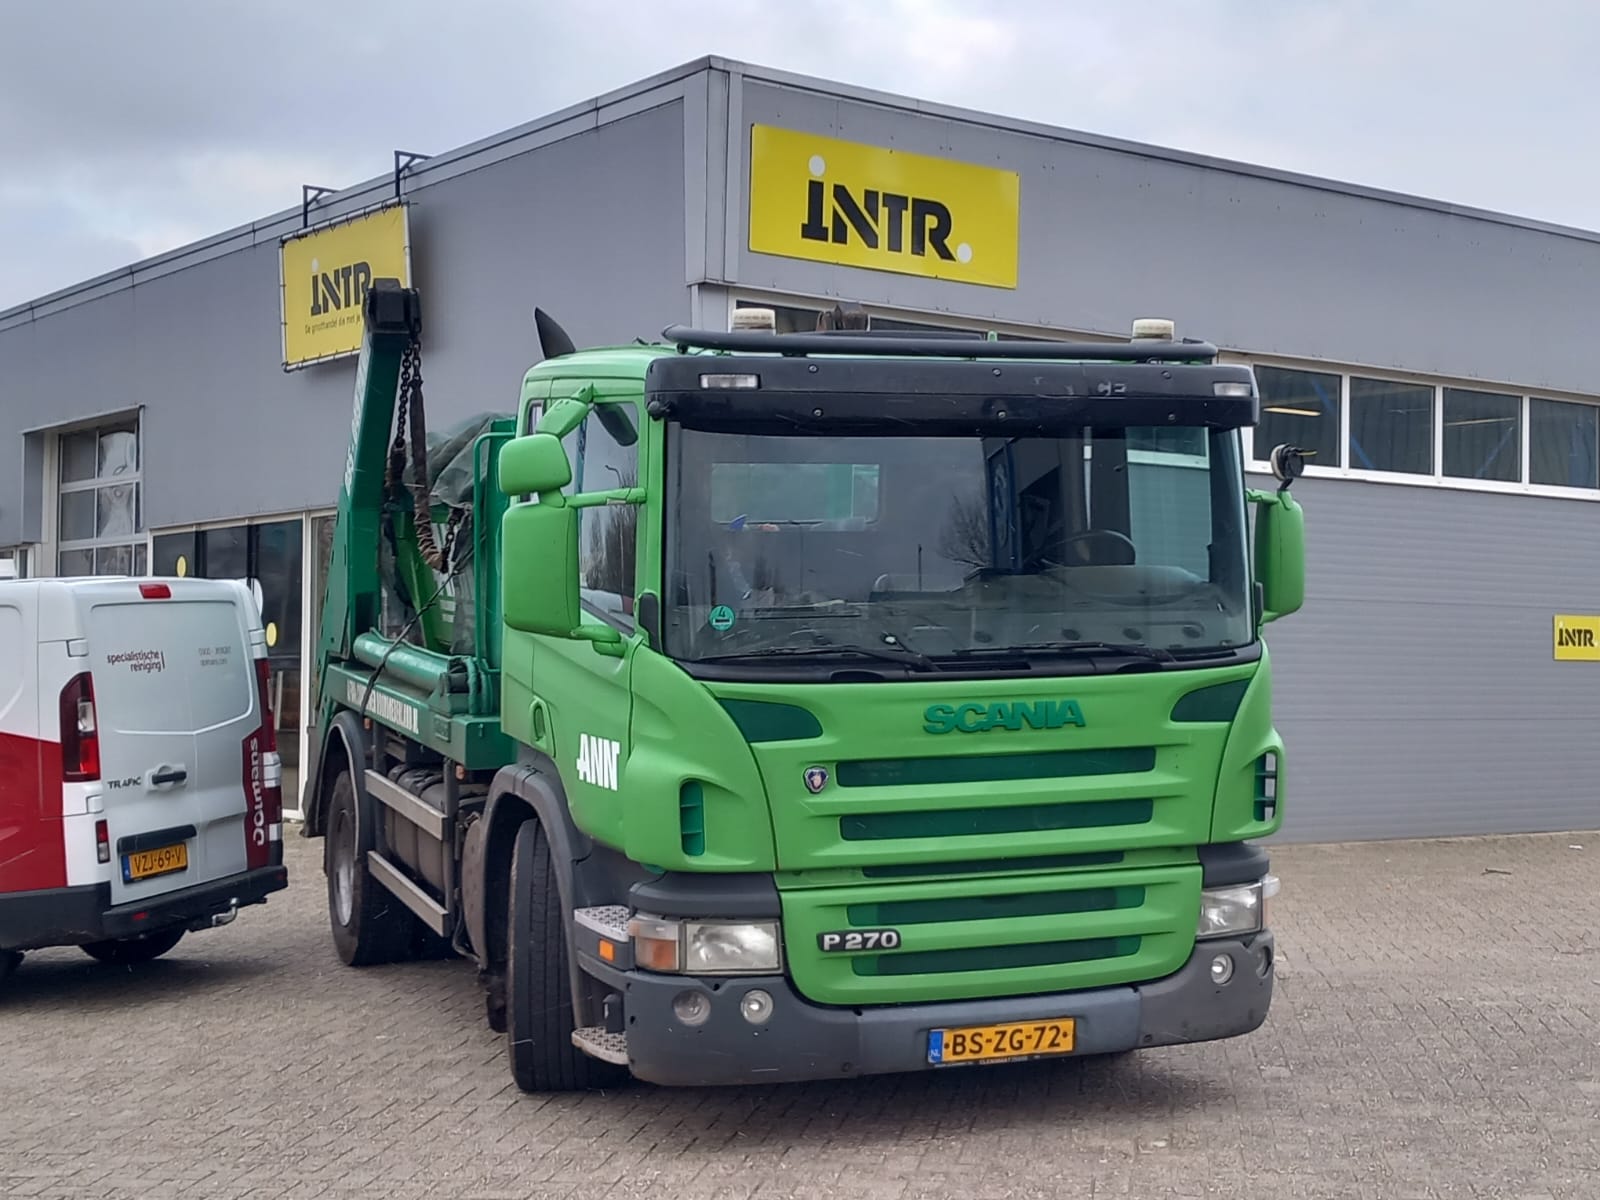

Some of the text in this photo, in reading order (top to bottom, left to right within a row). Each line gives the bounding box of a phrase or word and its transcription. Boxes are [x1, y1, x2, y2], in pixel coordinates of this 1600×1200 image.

[107, 649, 160, 666] specialistische
[130, 660, 162, 673] reiniging
[923, 699, 1086, 734] SCANIA
[107, 776, 142, 790] TRAFIC
[134, 850, 183, 874] VZJ-69-V
[823, 931, 899, 951] P 270
[952, 1025, 1061, 1056] BS-ZG-72
